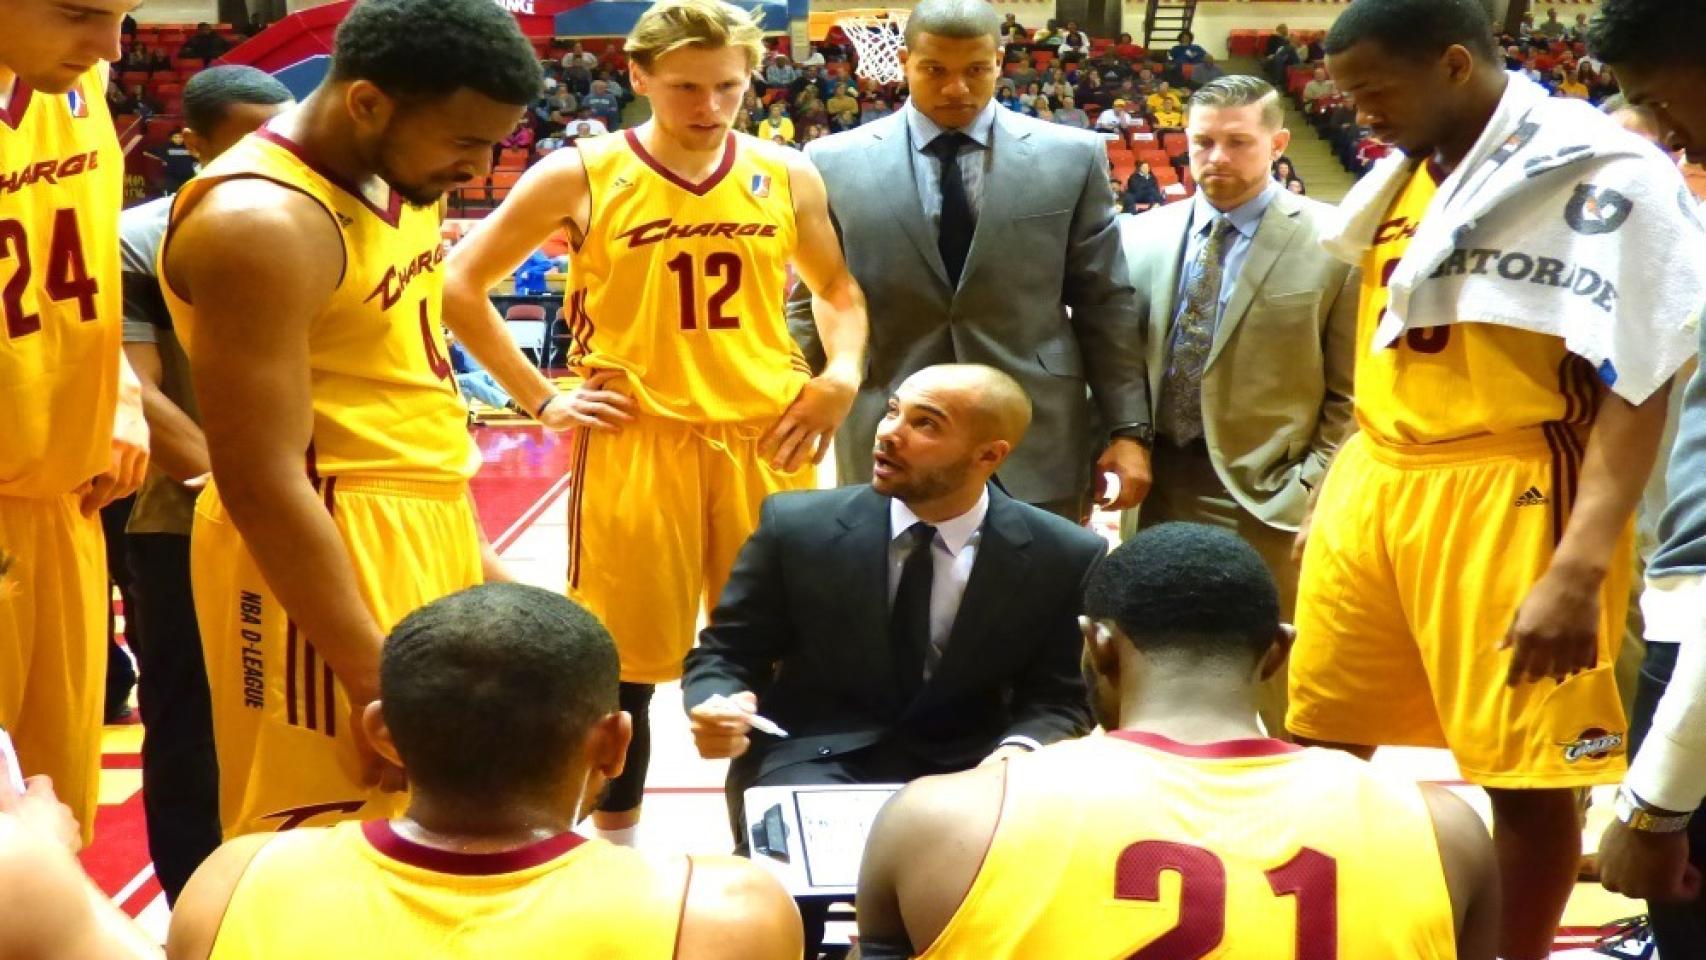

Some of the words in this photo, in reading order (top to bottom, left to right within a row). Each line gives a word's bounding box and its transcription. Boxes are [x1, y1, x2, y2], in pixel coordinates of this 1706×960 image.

[614, 217, 778, 248] CHARGE
[0, 208, 98, 339] 24
[667, 251, 742, 330] 12
[240, 590, 262, 625] NBA
[241, 629, 264, 709] D-LEAGUE
[1113, 840, 1337, 960] 21
